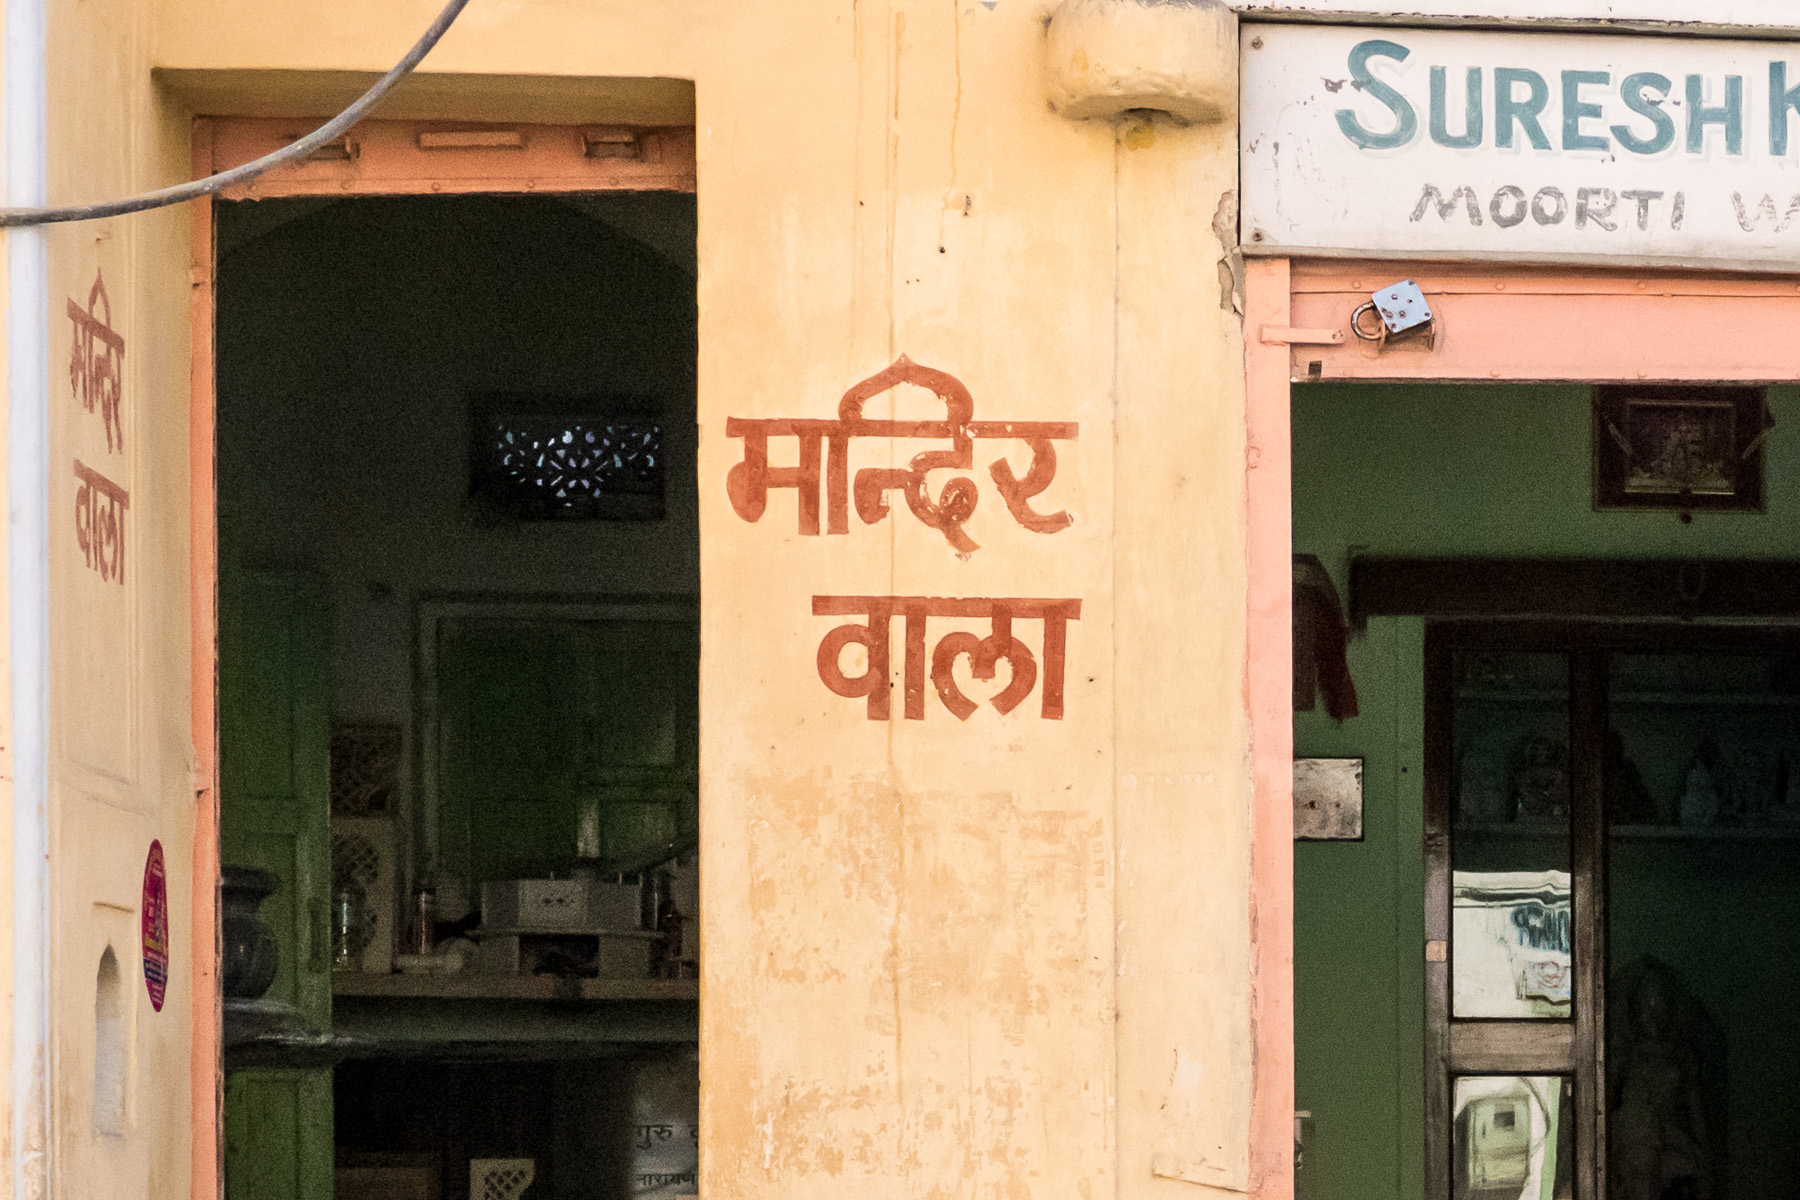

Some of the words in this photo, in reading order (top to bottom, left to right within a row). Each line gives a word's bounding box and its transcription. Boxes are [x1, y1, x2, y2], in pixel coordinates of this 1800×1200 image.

[1334, 39, 1742, 156] SURESH
[1409, 183, 1686, 233] MOORTI
[73, 457, 131, 587] वाला
[811, 594, 1083, 721] वाला
